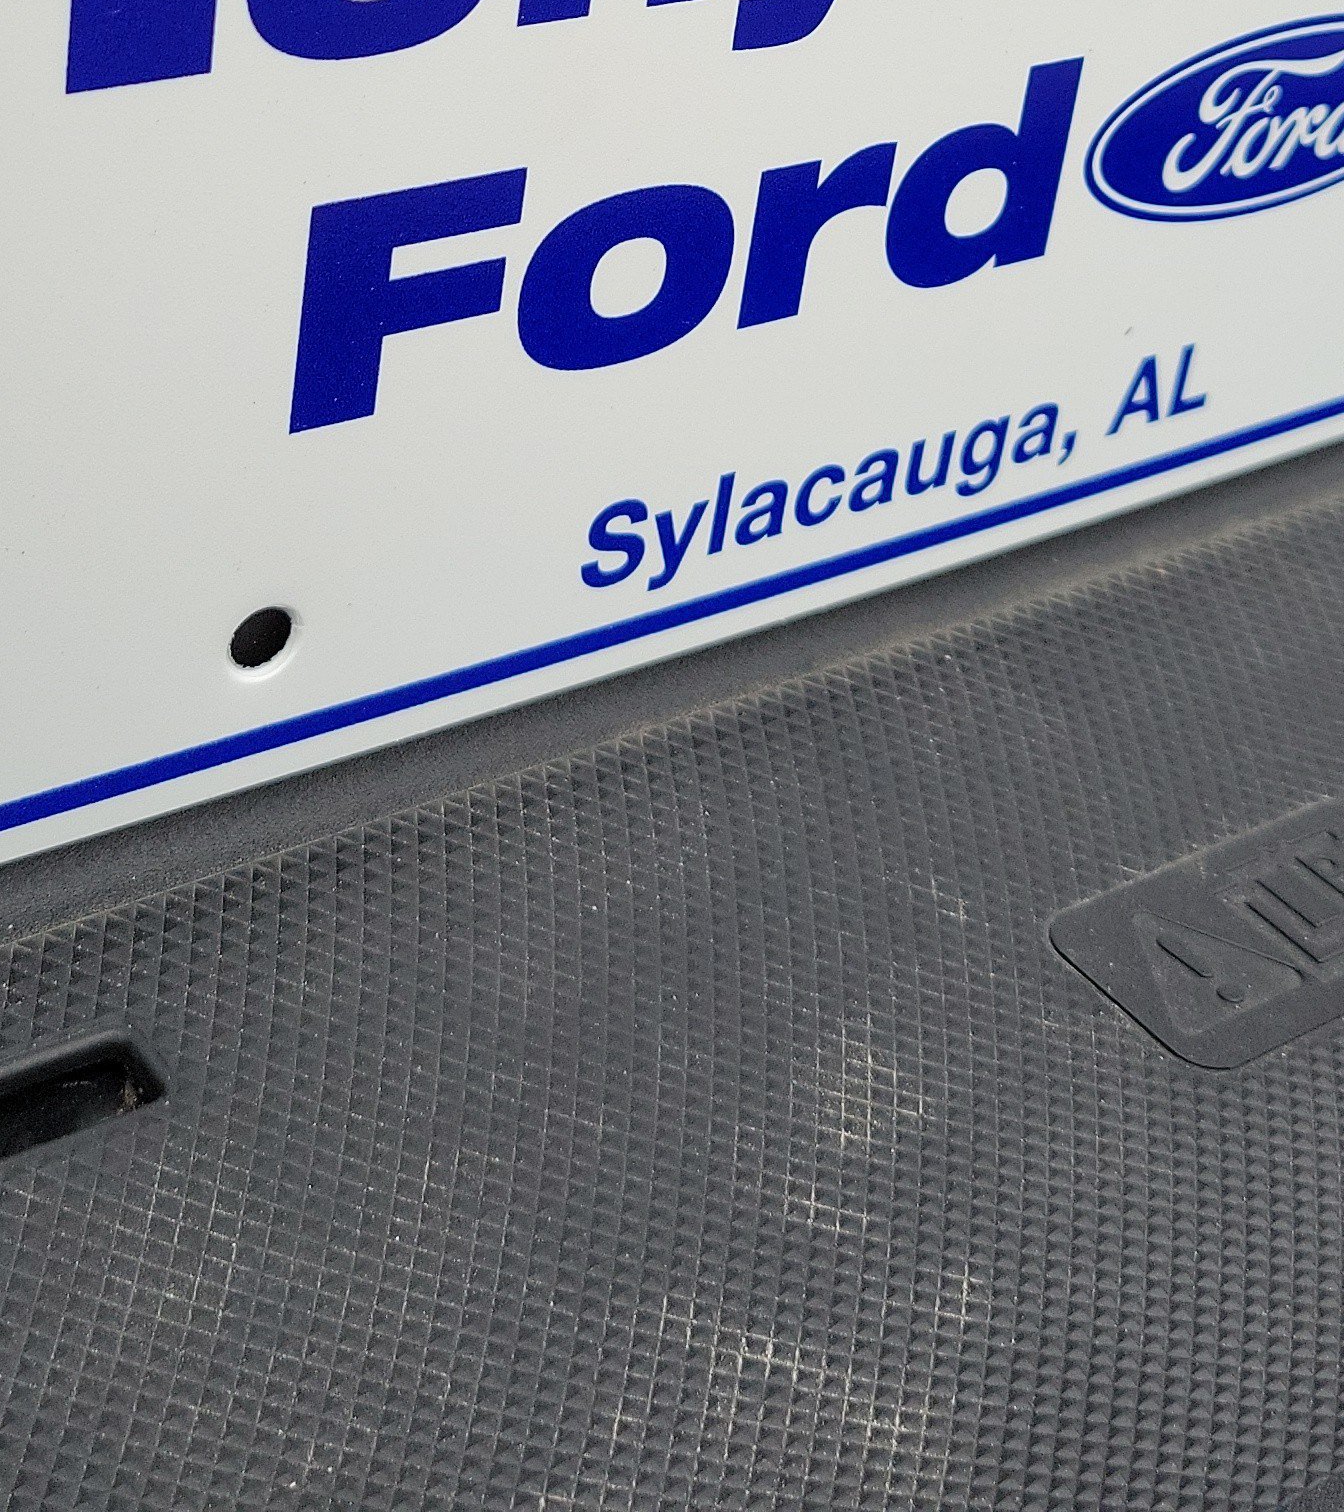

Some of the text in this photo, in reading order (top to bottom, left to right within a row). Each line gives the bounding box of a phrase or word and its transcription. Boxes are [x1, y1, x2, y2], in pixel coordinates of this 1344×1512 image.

[287, 55, 1086, 435] Ford
[578, 342, 1208, 593] Sylacauga, AL
